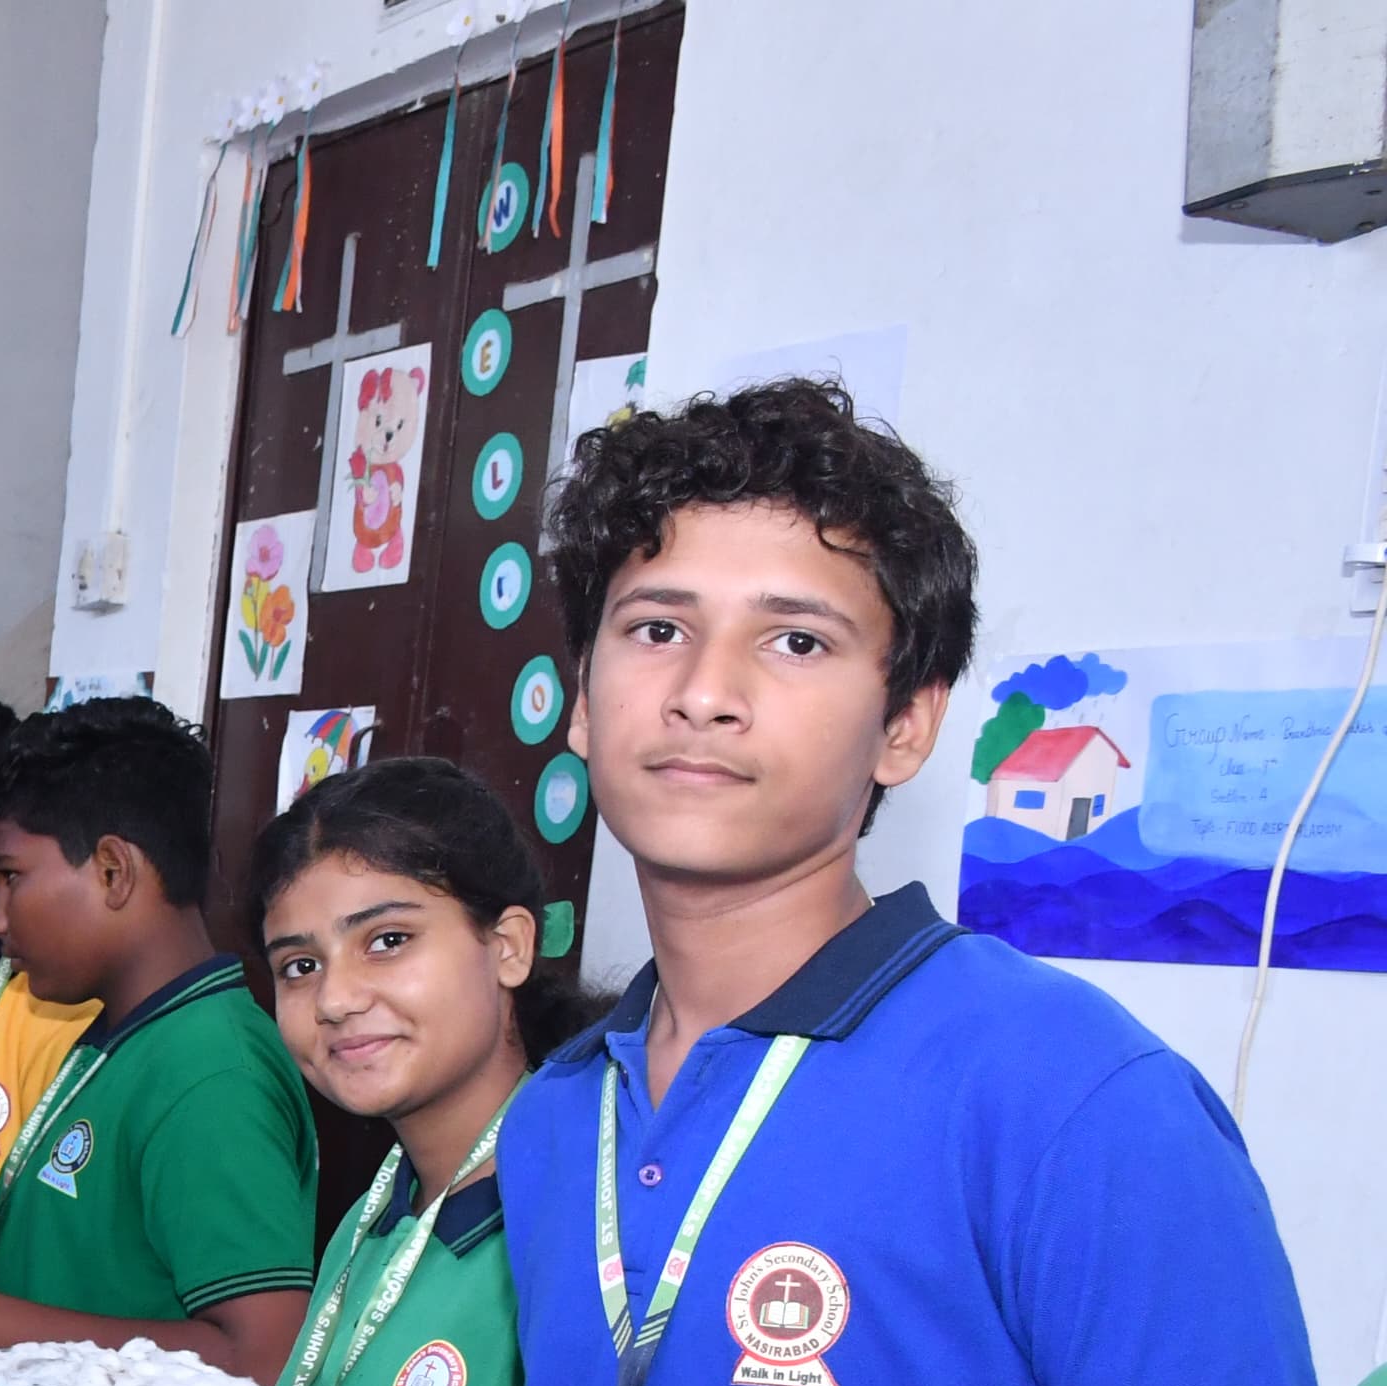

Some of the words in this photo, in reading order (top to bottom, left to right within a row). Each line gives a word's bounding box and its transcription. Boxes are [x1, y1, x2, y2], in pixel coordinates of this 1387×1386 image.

[600, 1143, 614, 1211] JOHN'S
[681, 1200, 705, 1237] ST.
[703, 1126, 748, 1203] JOHN'S
[601, 1213, 614, 1246] ST.
[370, 1226, 429, 1323] SECONDARY
[734, 1264, 765, 1305] John's
[764, 1253, 831, 1284] Secondary
[821, 1284, 844, 1337] School
[301, 1315, 331, 1370] JOHN'S
[745, 1332, 820, 1358] NASIRABAD
[741, 1366, 769, 1379] Walk
[773, 1368, 784, 1380] in
[789, 1370, 823, 1386] Light
